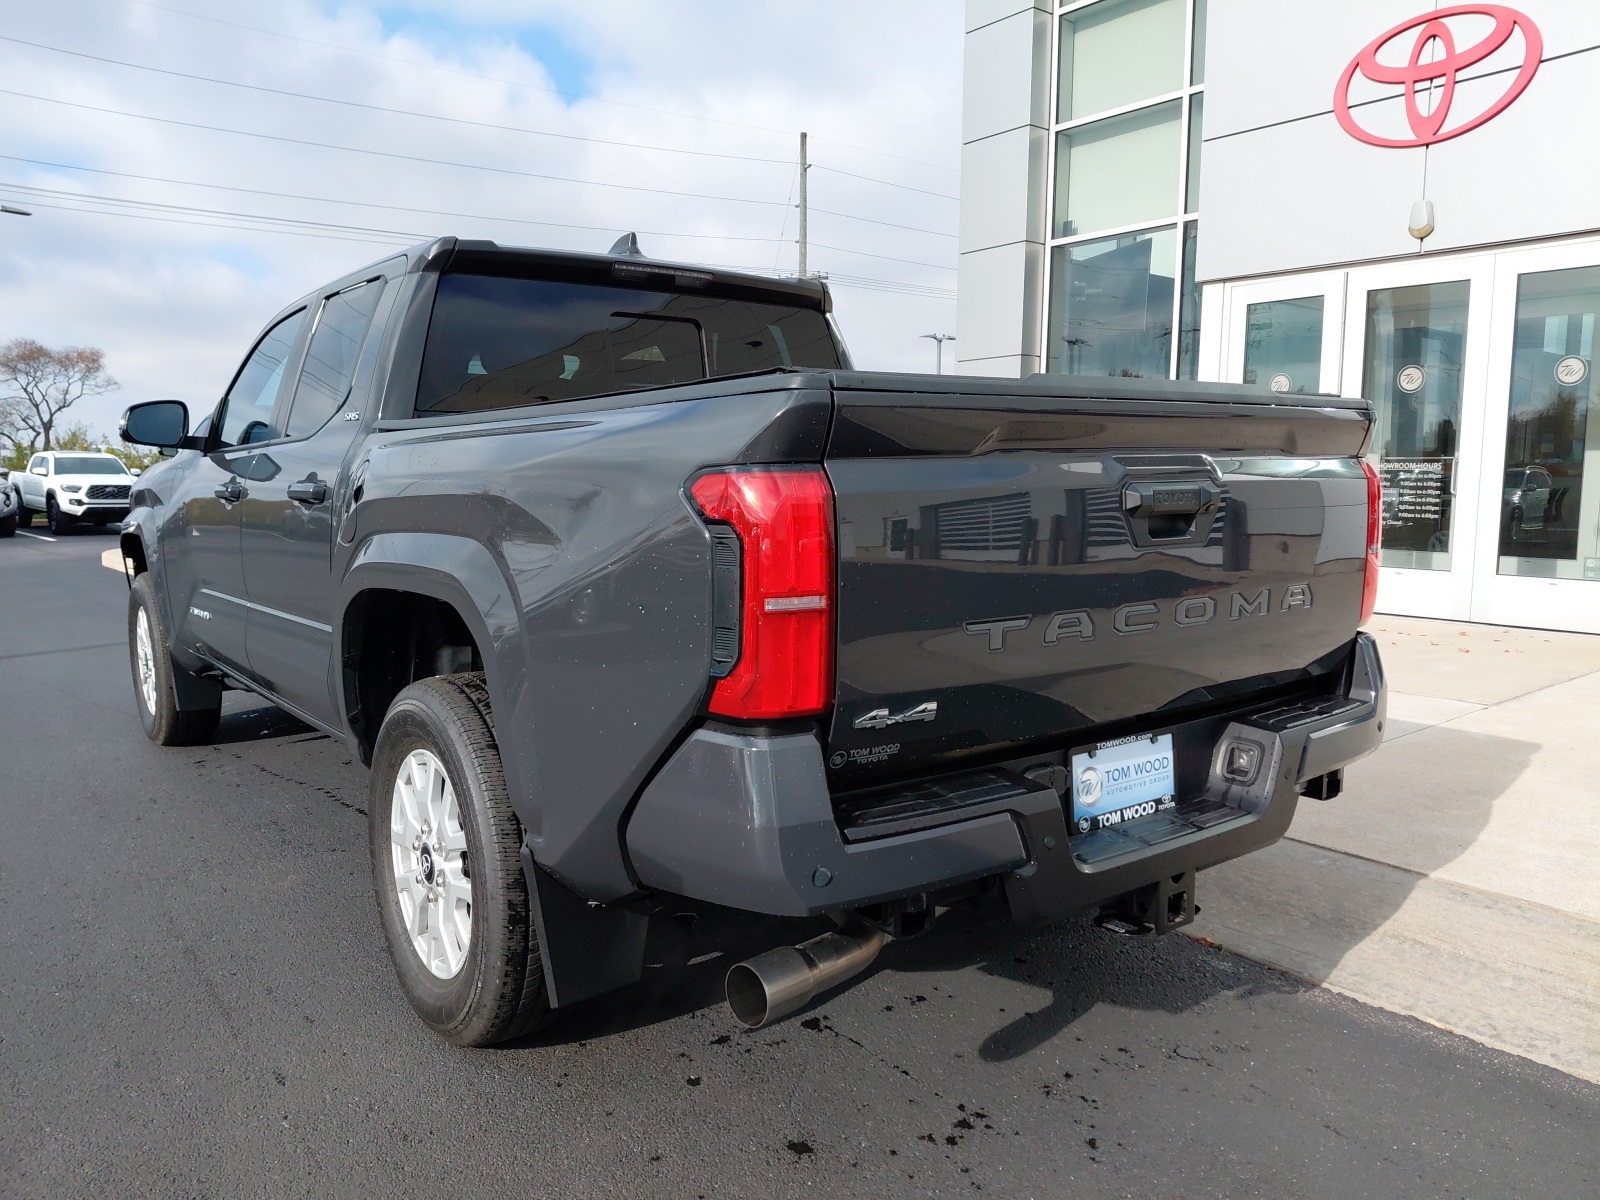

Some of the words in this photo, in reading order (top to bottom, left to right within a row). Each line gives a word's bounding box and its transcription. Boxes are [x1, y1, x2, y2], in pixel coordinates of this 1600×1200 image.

[1379, 462, 1416, 470] HOWROOM
[1155, 491, 1199, 505] TOYOTA
[962, 581, 1314, 654] TACOMA
[1096, 732, 1153, 750] TOMWOOD.com
[849, 747, 870, 757] TOM
[871, 743, 900, 754] WOOD
[856, 754, 888, 764] TOYOTA
[1105, 765, 1131, 783] TOM
[1133, 756, 1170, 776] WOOD
[1107, 779, 1147, 796] AUTOMOTIVE
[1149, 774, 1170, 785] GROUP
[1158, 801, 1175, 811] TOYOTA
[1097, 810, 1122, 828] TOM
[1123, 801, 1156, 819] WOOD
